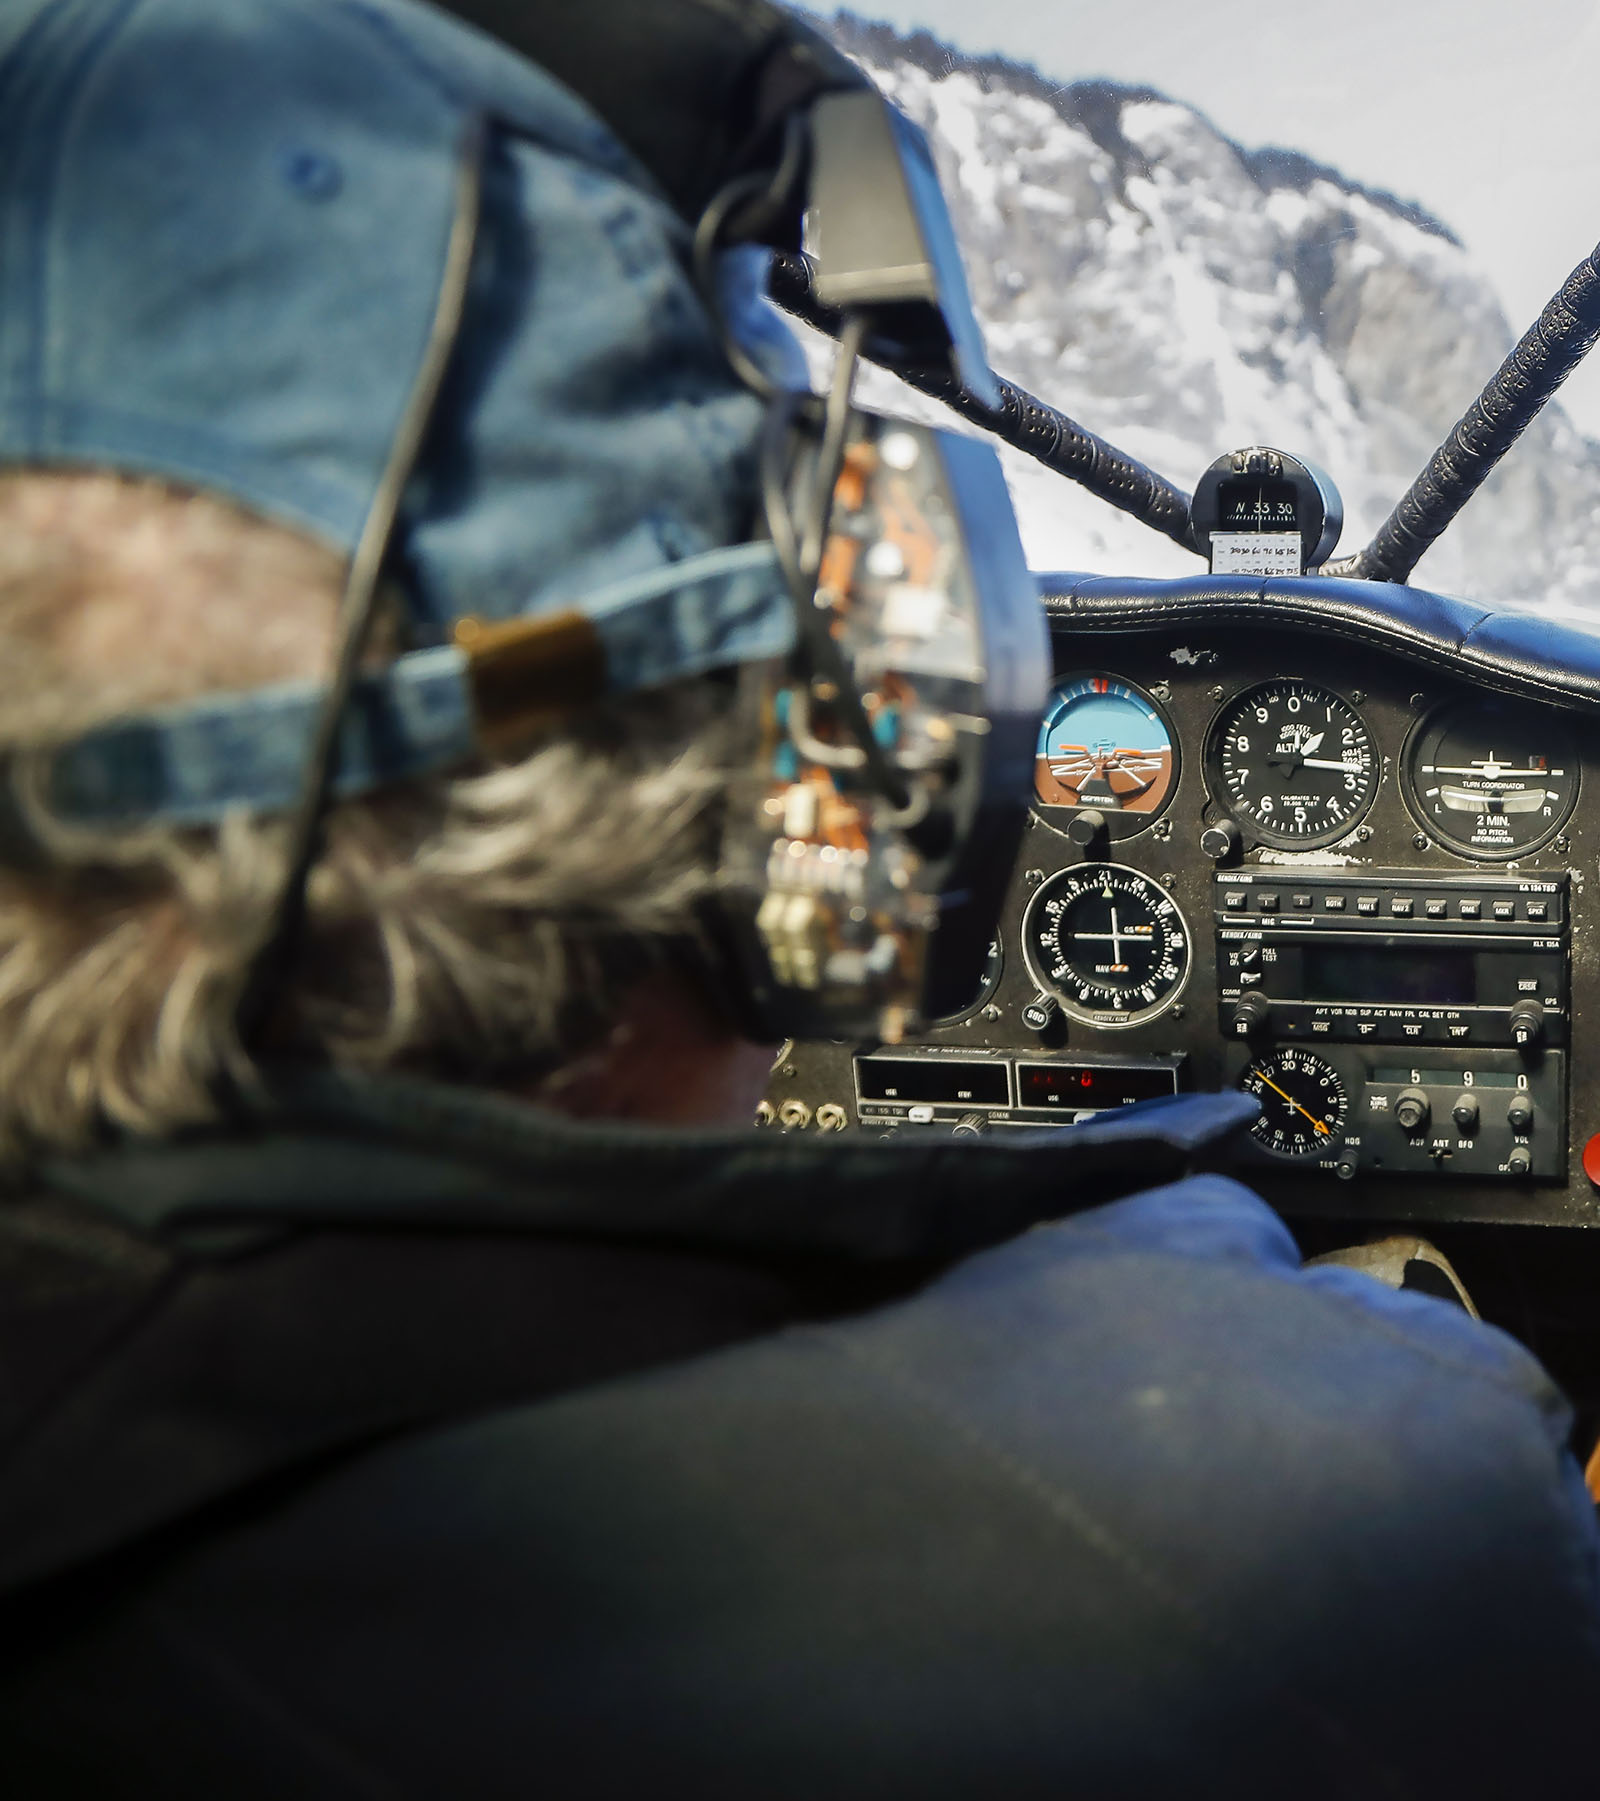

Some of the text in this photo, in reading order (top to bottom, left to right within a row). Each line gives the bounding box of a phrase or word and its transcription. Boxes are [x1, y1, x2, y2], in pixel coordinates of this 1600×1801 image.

[1236, 502, 1292, 514] N 33 30
[1287, 696, 1300, 712] 0
[1256, 707, 1269, 724] 9
[1326, 706, 1331, 722] 1
[1342, 728, 1354, 745] 2
[1237, 735, 1249, 752] 8
[1237, 769, 1249, 785] 7
[1344, 774, 1356, 790] 3
[1462, 781, 1525, 790] TURN COORDINATOR
[1260, 796, 1273, 813] 6
[1326, 796, 1339, 810] 4
[1434, 804, 1442, 813] L
[1294, 807, 1307, 822] 5
[1543, 806, 1551, 816] R
[1476, 815, 1510, 826] 2 MIN.
[1471, 835, 1513, 843] INFORMATION
[1098, 870, 1111, 881] 21
[1131, 876, 1146, 891] 24
[1045, 899, 1060, 915] 15
[1157, 899, 1174, 916] W
[1039, 932, 1052, 948] 12
[1170, 932, 1184, 948] 30
[1095, 965, 1110, 973] NAV
[1163, 963, 1179, 980] 33
[1141, 985, 1157, 1003] N
[1406, 1027, 1419, 1035] CLR
[1263, 1066, 1275, 1078] 27
[1281, 1061, 1296, 1071] 30
[1302, 1063, 1316, 1076] 33
[1320, 1077, 1330, 1087] 0
[1411, 1069, 1528, 1090] 5 9 0
[1252, 1080, 1264, 1094] 24
[1327, 1096, 1337, 1104] 3
[1274, 1129, 1285, 1140] 15
[1294, 1133, 1306, 1144] 12
[1514, 1136, 1529, 1144] VOL
[1345, 1137, 1361, 1145] HDG
[1410, 1138, 1424, 1147] ADF
[1433, 1139, 1449, 1148] ANT
[1458, 1140, 1473, 1149] BFO
